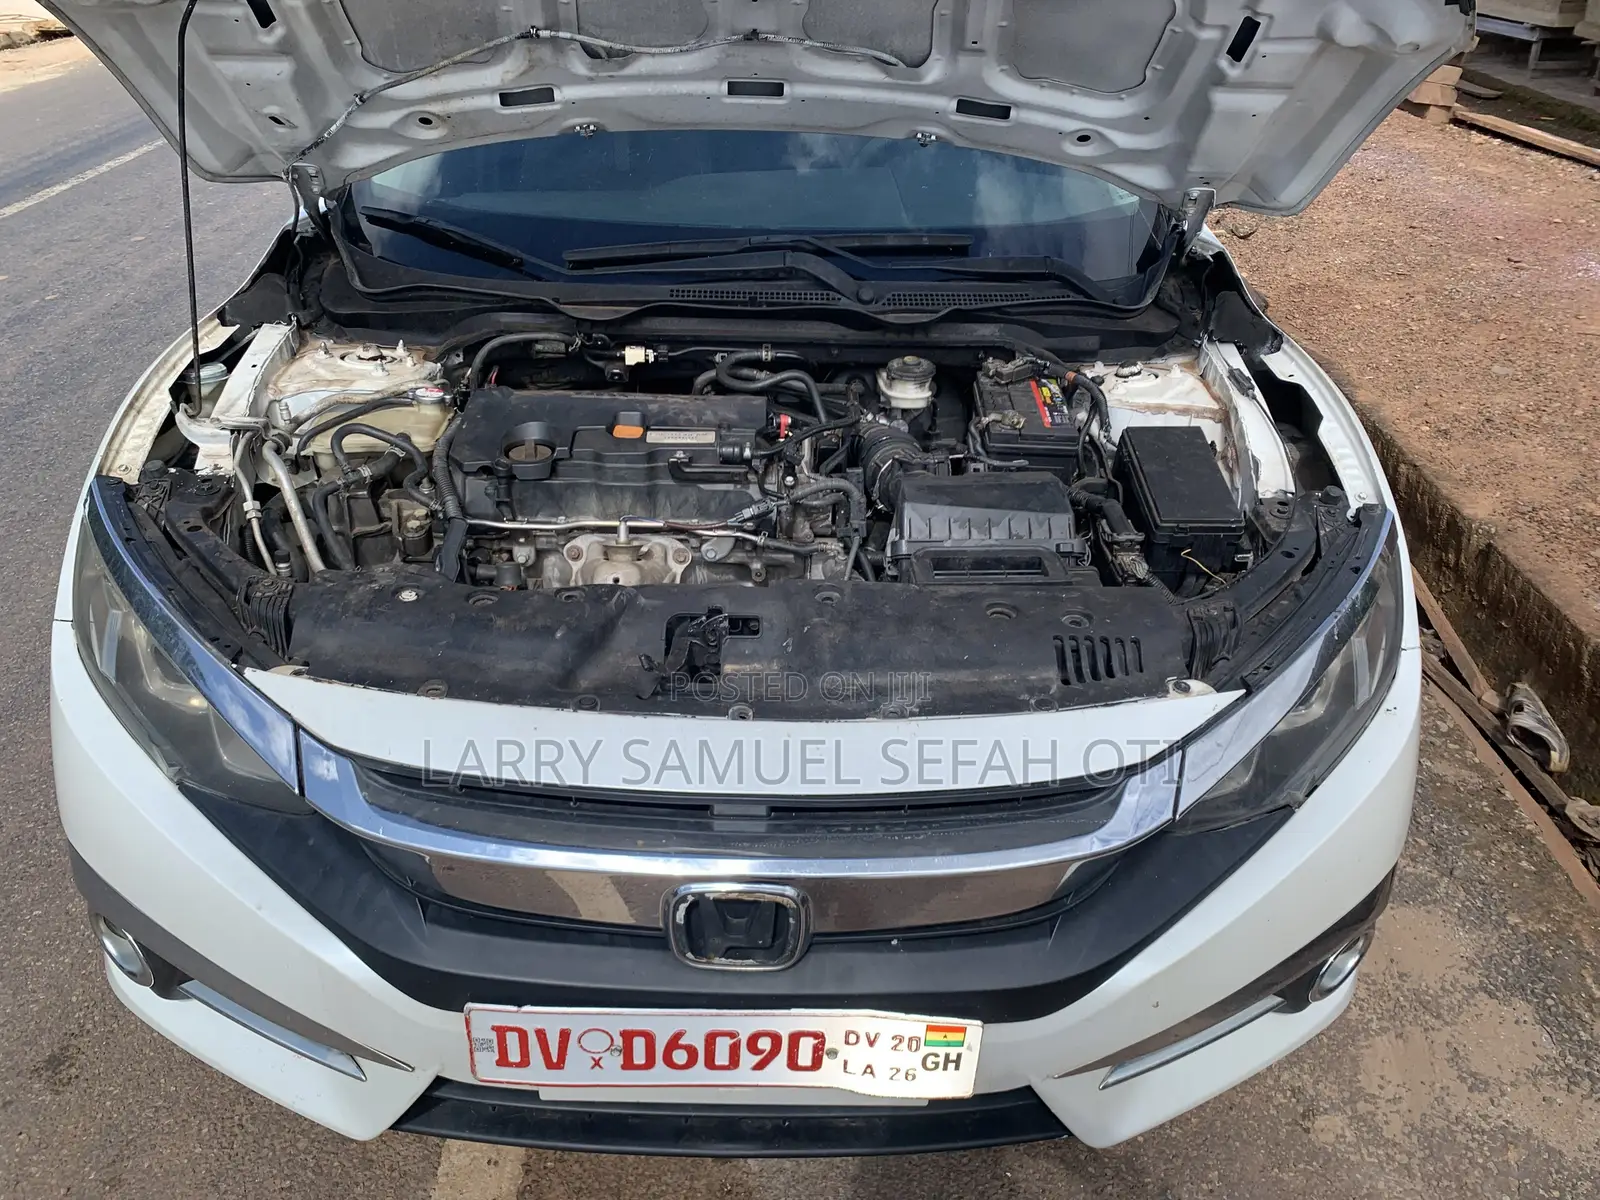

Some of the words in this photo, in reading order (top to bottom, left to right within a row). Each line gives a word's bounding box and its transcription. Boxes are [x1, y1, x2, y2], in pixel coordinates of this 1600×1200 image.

[490, 1025, 572, 1070] DV
[619, 1028, 827, 1072] D6090
[844, 1029, 881, 1048] DV
[890, 1034, 921, 1053] 20
[843, 1059, 876, 1079] LA
[889, 1066, 917, 1081] 26
[921, 1052, 963, 1072] GH
